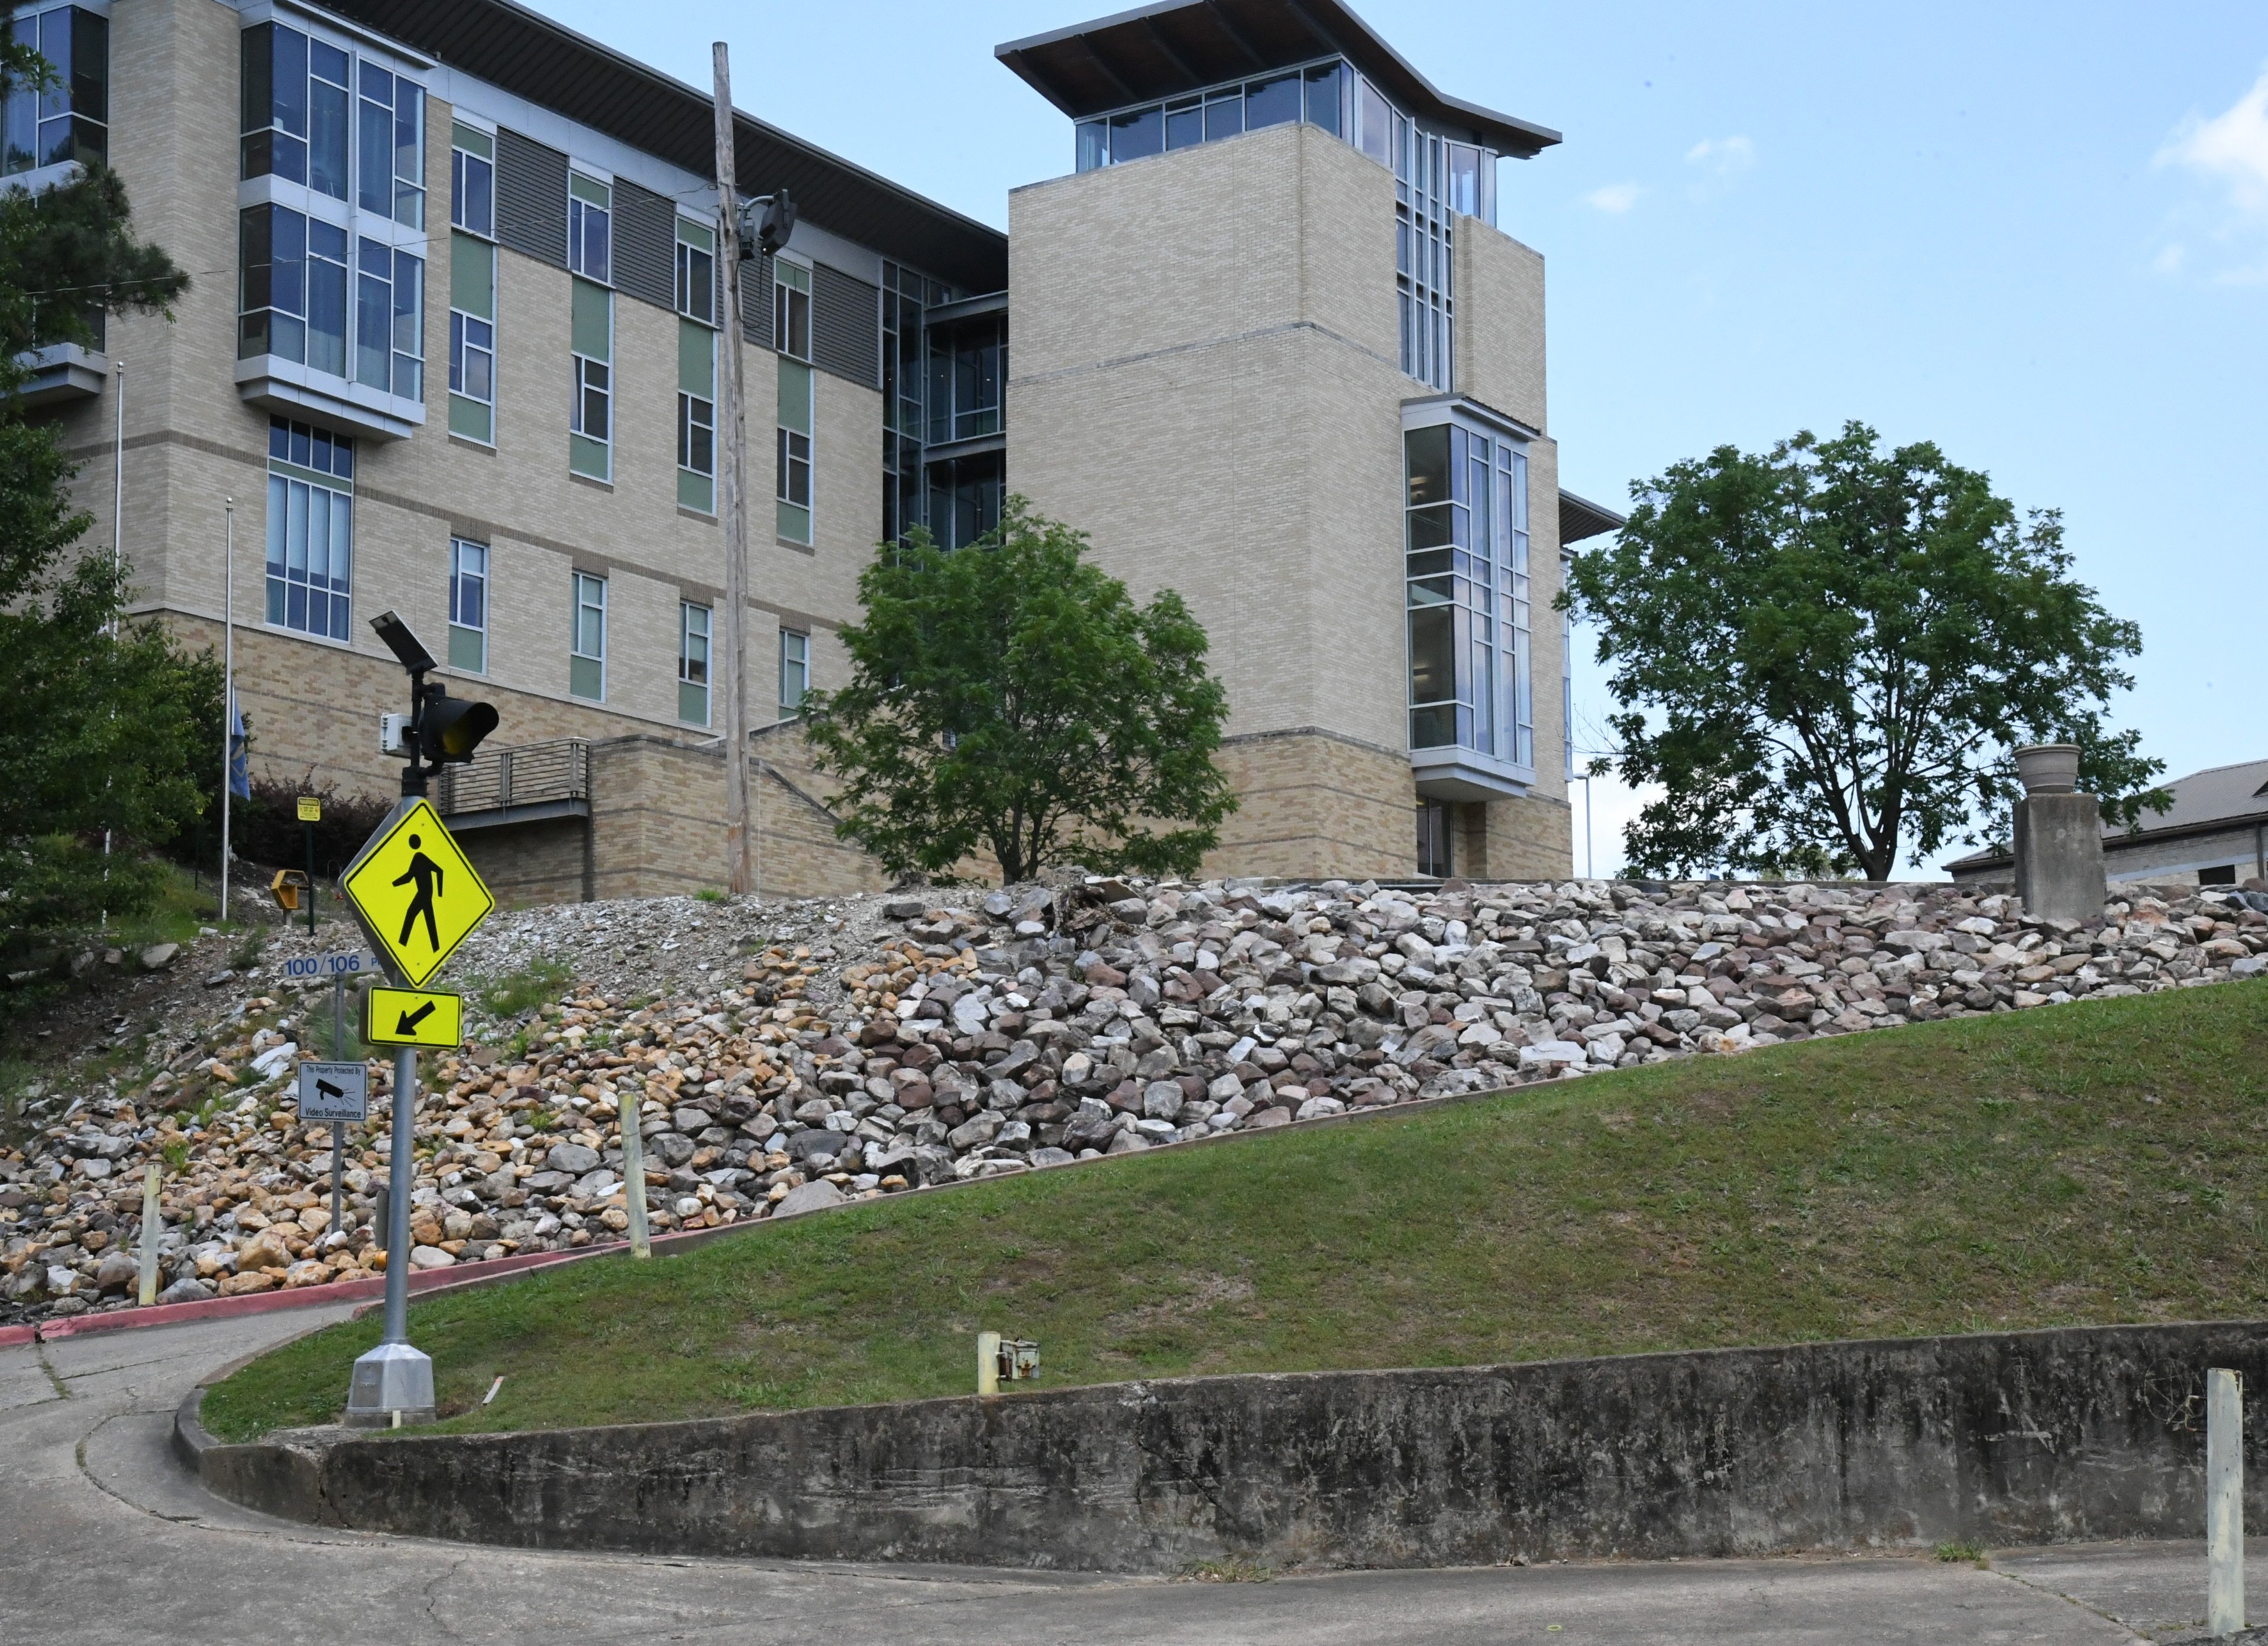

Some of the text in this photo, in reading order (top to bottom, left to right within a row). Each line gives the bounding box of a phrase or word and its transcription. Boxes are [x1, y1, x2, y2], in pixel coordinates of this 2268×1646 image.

[316, 1065, 333, 1075] Property
[334, 1066, 354, 1074] Protected
[355, 1067, 361, 1075] By
[305, 1107, 361, 1118] Video Surveillance
